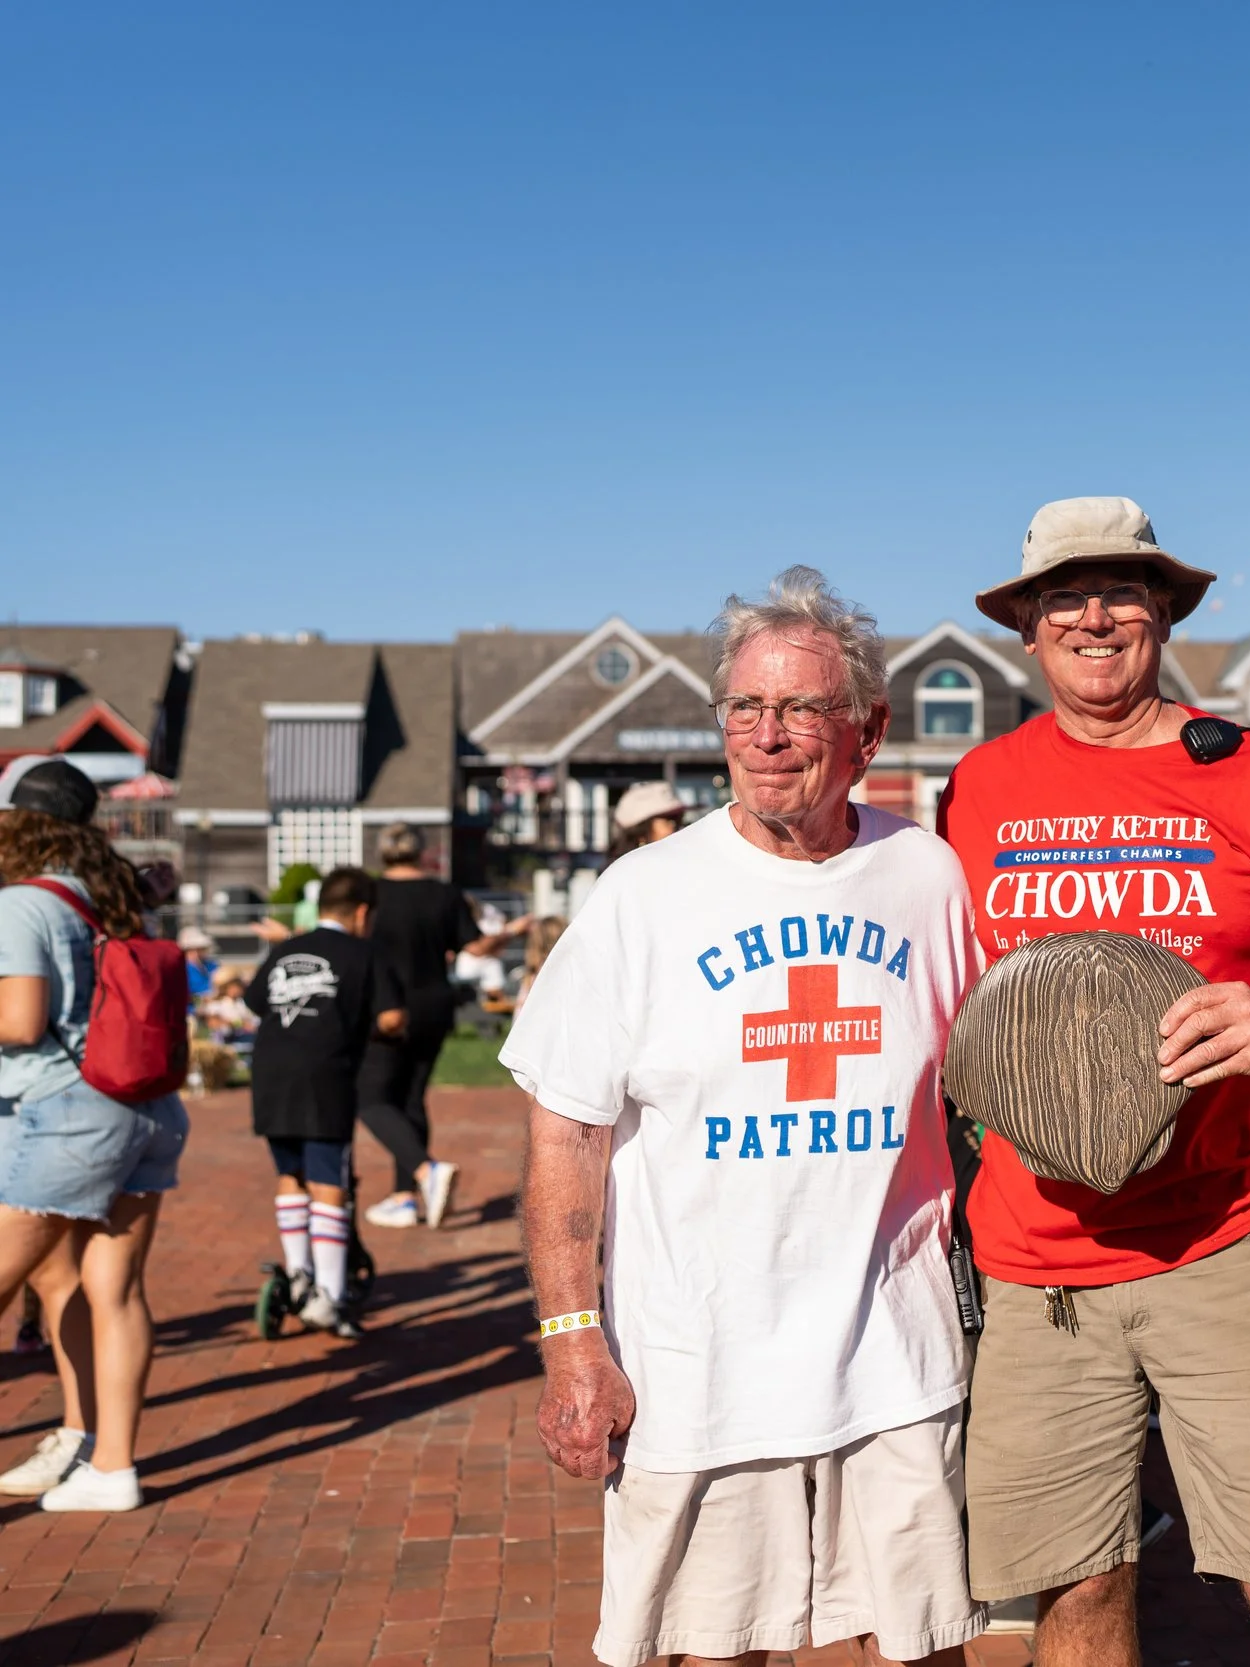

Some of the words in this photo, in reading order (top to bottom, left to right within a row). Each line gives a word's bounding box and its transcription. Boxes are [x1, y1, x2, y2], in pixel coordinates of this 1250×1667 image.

[996, 815, 1106, 844] COUNTRY
[1110, 815, 1212, 843] KETTLE
[1015, 849, 1111, 862] CHOWDERFEST
[1120, 848, 1183, 860] CHAMPS
[985, 869, 1217, 919] CHOWDA
[696, 913, 912, 991] CHOWDA
[993, 929, 1008, 949] In
[1016, 929, 1036, 947] th
[745, 1022, 817, 1049] COUNTRY
[823, 1019, 879, 1043] KETTLE
[705, 1105, 905, 1160] PATROL
